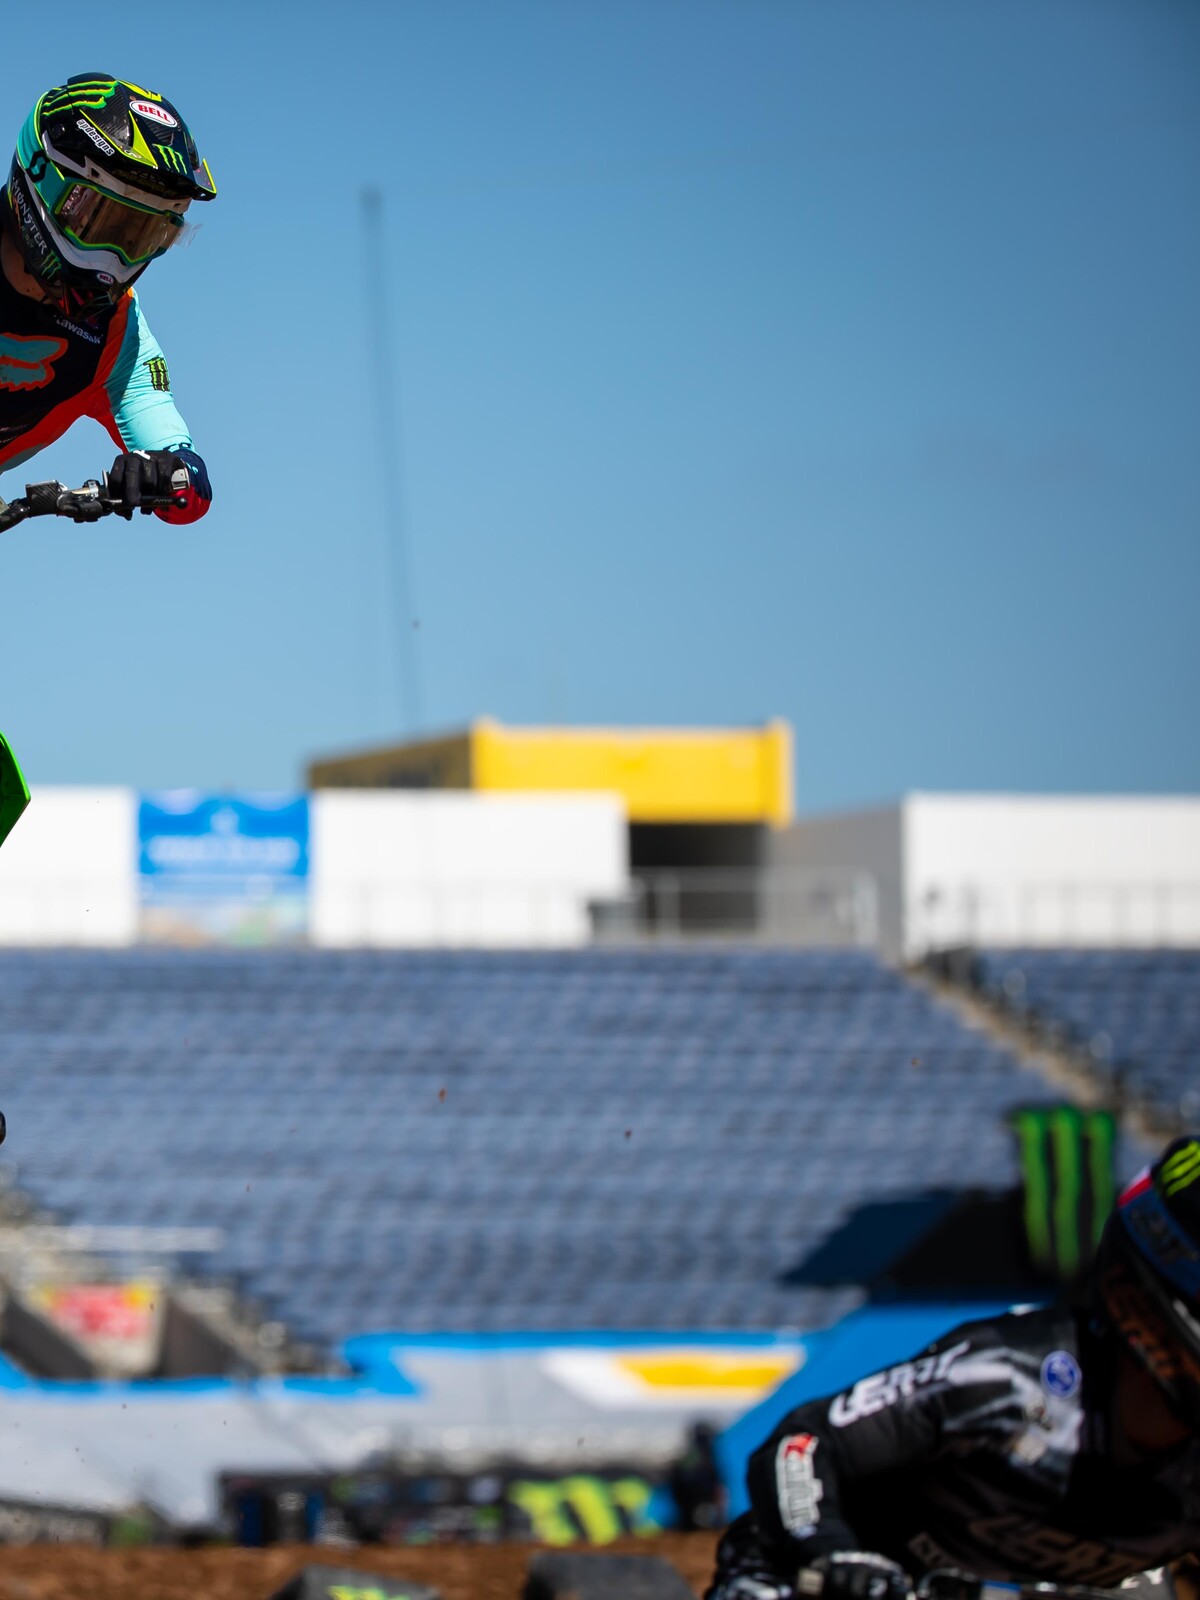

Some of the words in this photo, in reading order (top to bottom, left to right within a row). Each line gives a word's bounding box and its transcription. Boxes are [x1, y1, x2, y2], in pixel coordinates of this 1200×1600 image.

[137, 103, 171, 123] BELL
[77, 119, 115, 156] apdesigns
[12, 179, 47, 255] MONSTER
